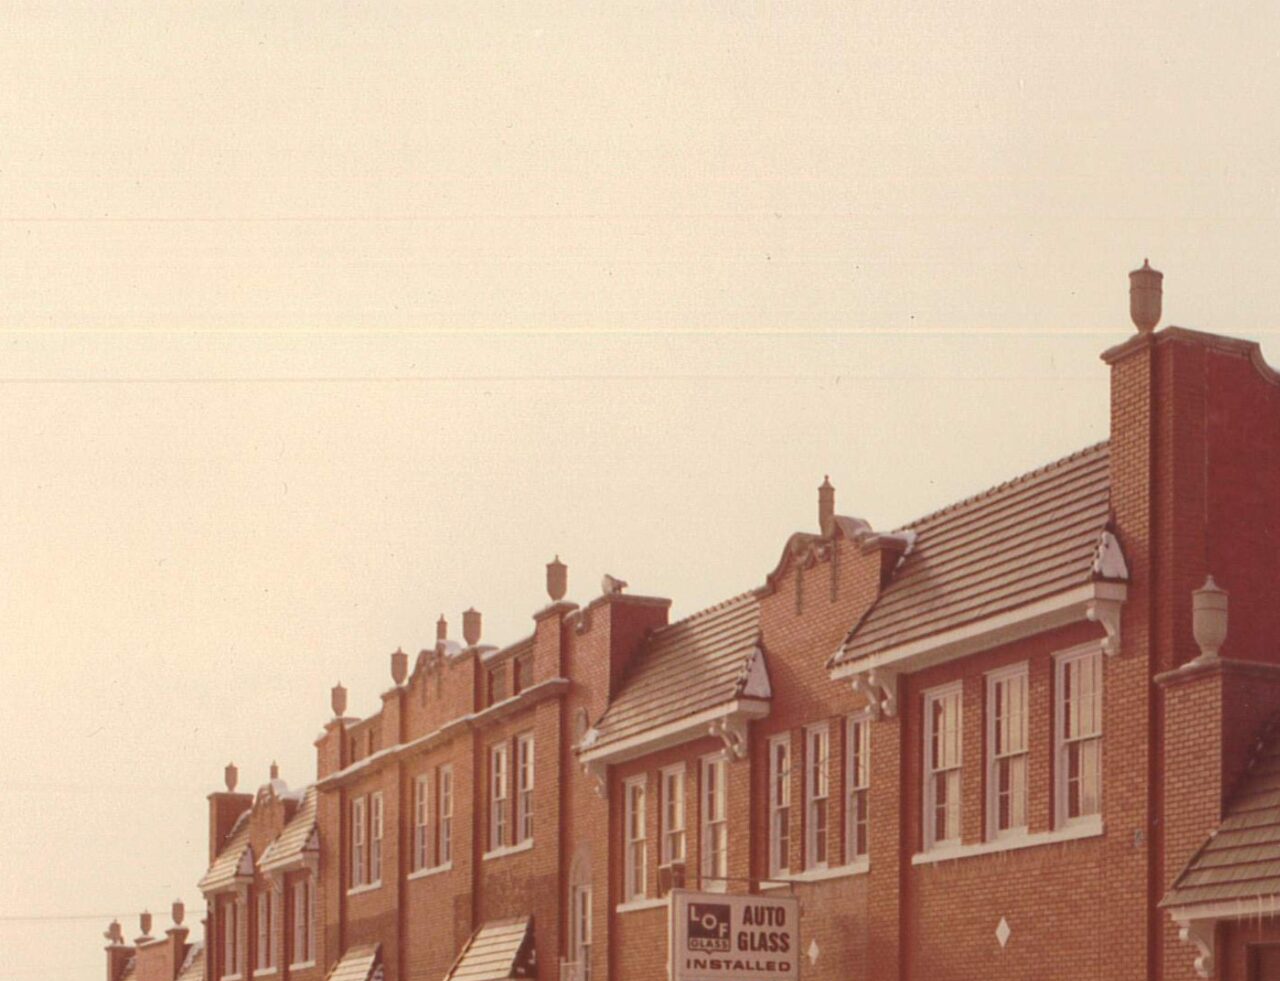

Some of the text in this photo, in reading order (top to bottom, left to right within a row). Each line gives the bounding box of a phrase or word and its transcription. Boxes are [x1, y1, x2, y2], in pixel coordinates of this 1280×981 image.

[742, 904, 787, 928] AUTO
[689, 938, 729, 950] GLASS
[737, 930, 791, 953] GLASS
[686, 958, 792, 973] INSTALLED
